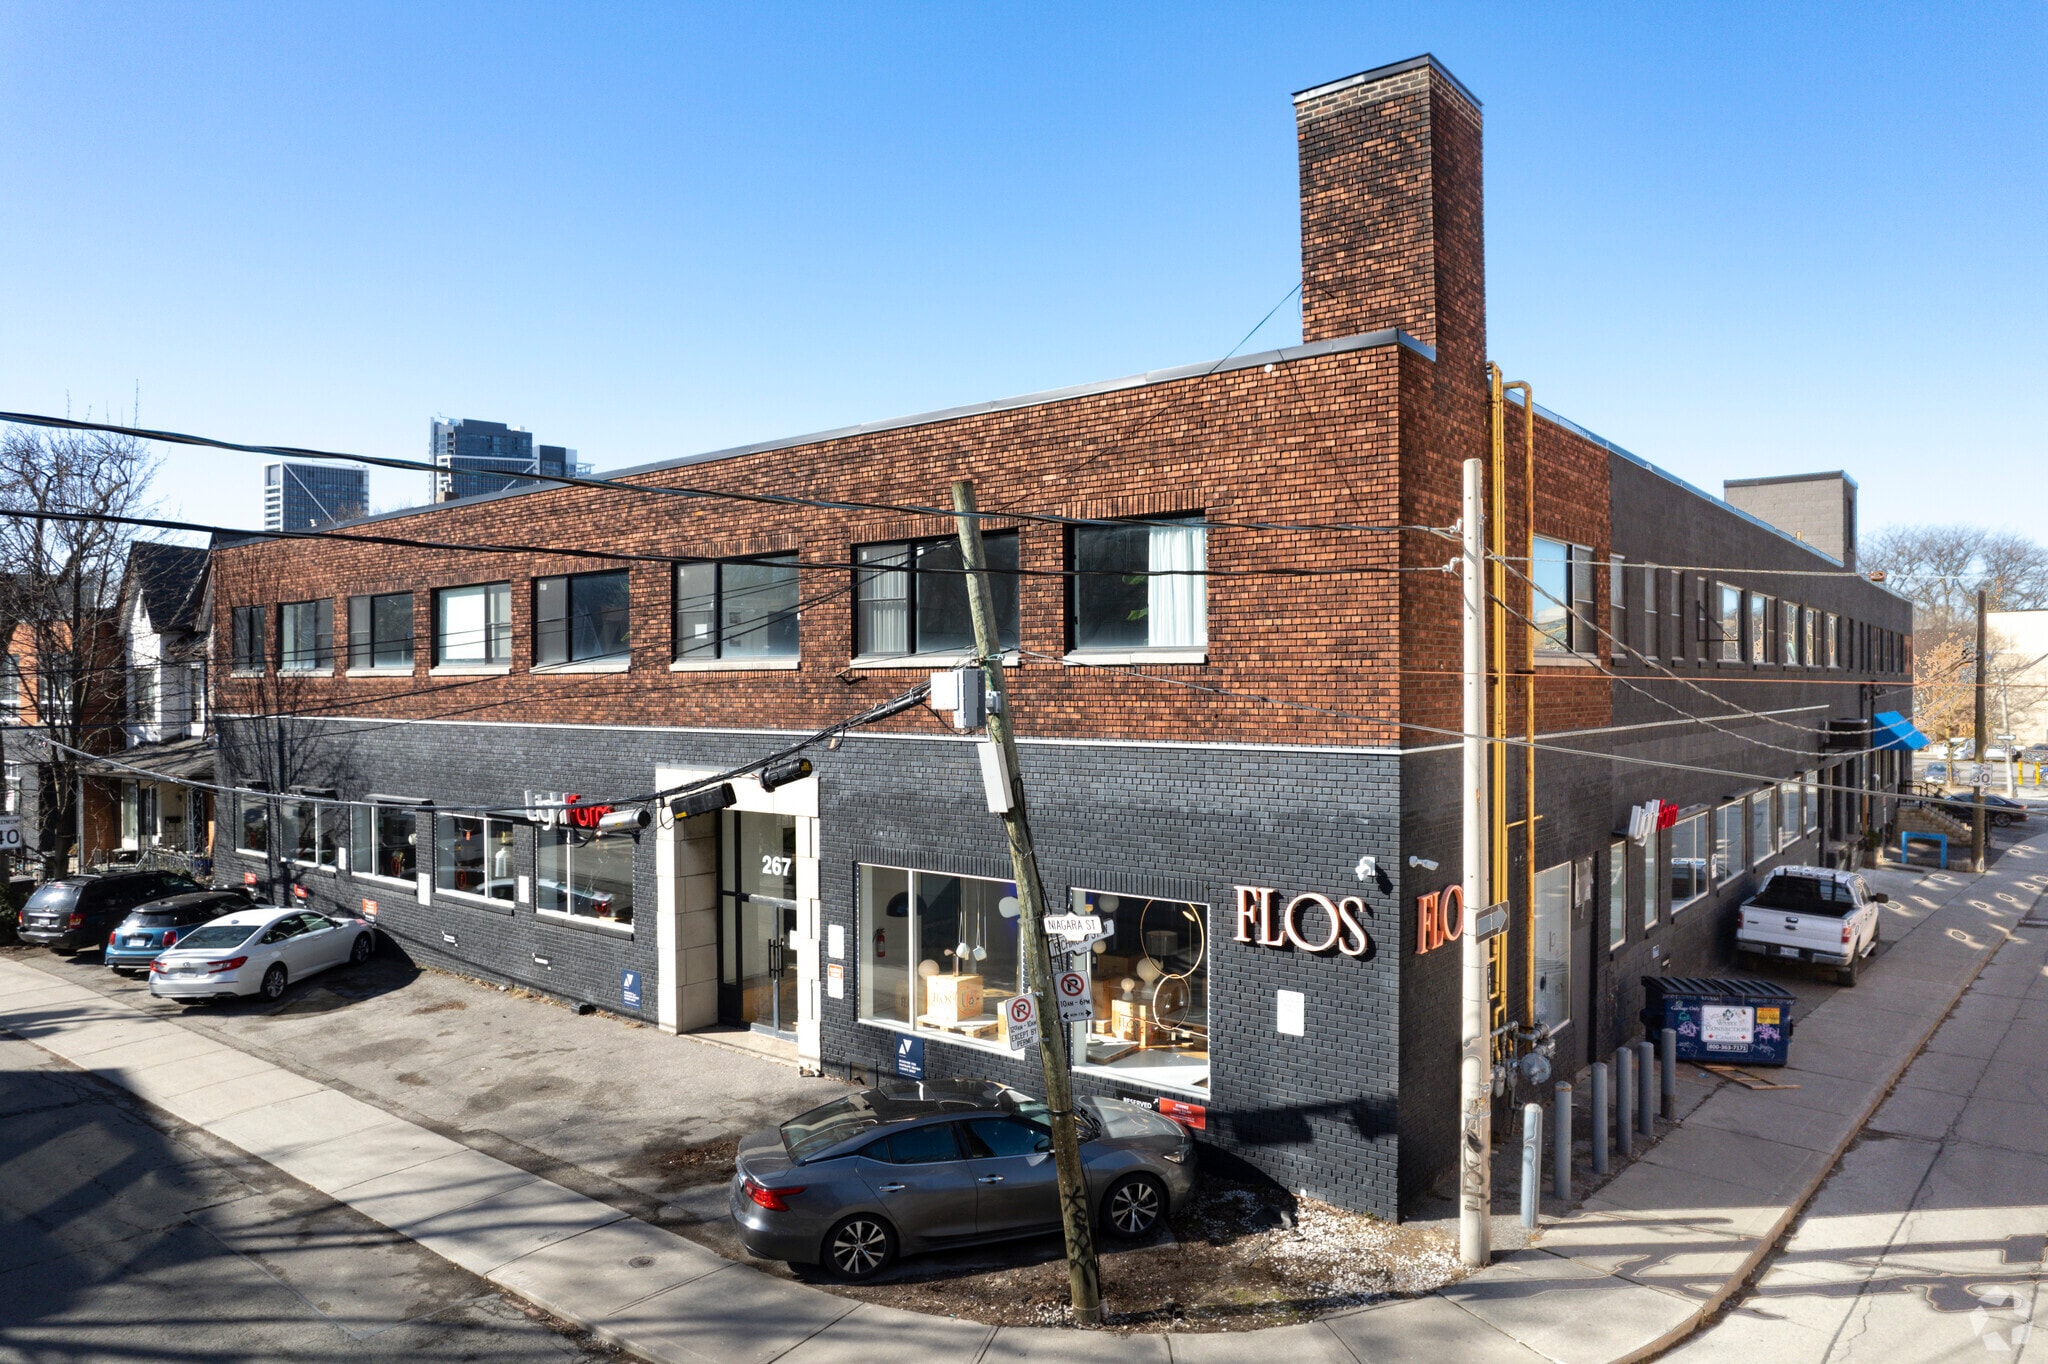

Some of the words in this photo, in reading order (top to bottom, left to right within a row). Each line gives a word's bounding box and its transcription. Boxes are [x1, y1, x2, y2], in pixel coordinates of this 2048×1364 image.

[1973, 773, 1990, 784] 30
[762, 855, 791, 876] 267
[1047, 919, 1084, 931] NIAGARA
[1233, 885, 1368, 956] FLOS
[1011, 1030, 1029, 1042] EXCEPT
[1030, 1028, 1037, 1036] BY
[1016, 1036, 1034, 1047] PERMIT
[1122, 1096, 1153, 1109] RESERVED
